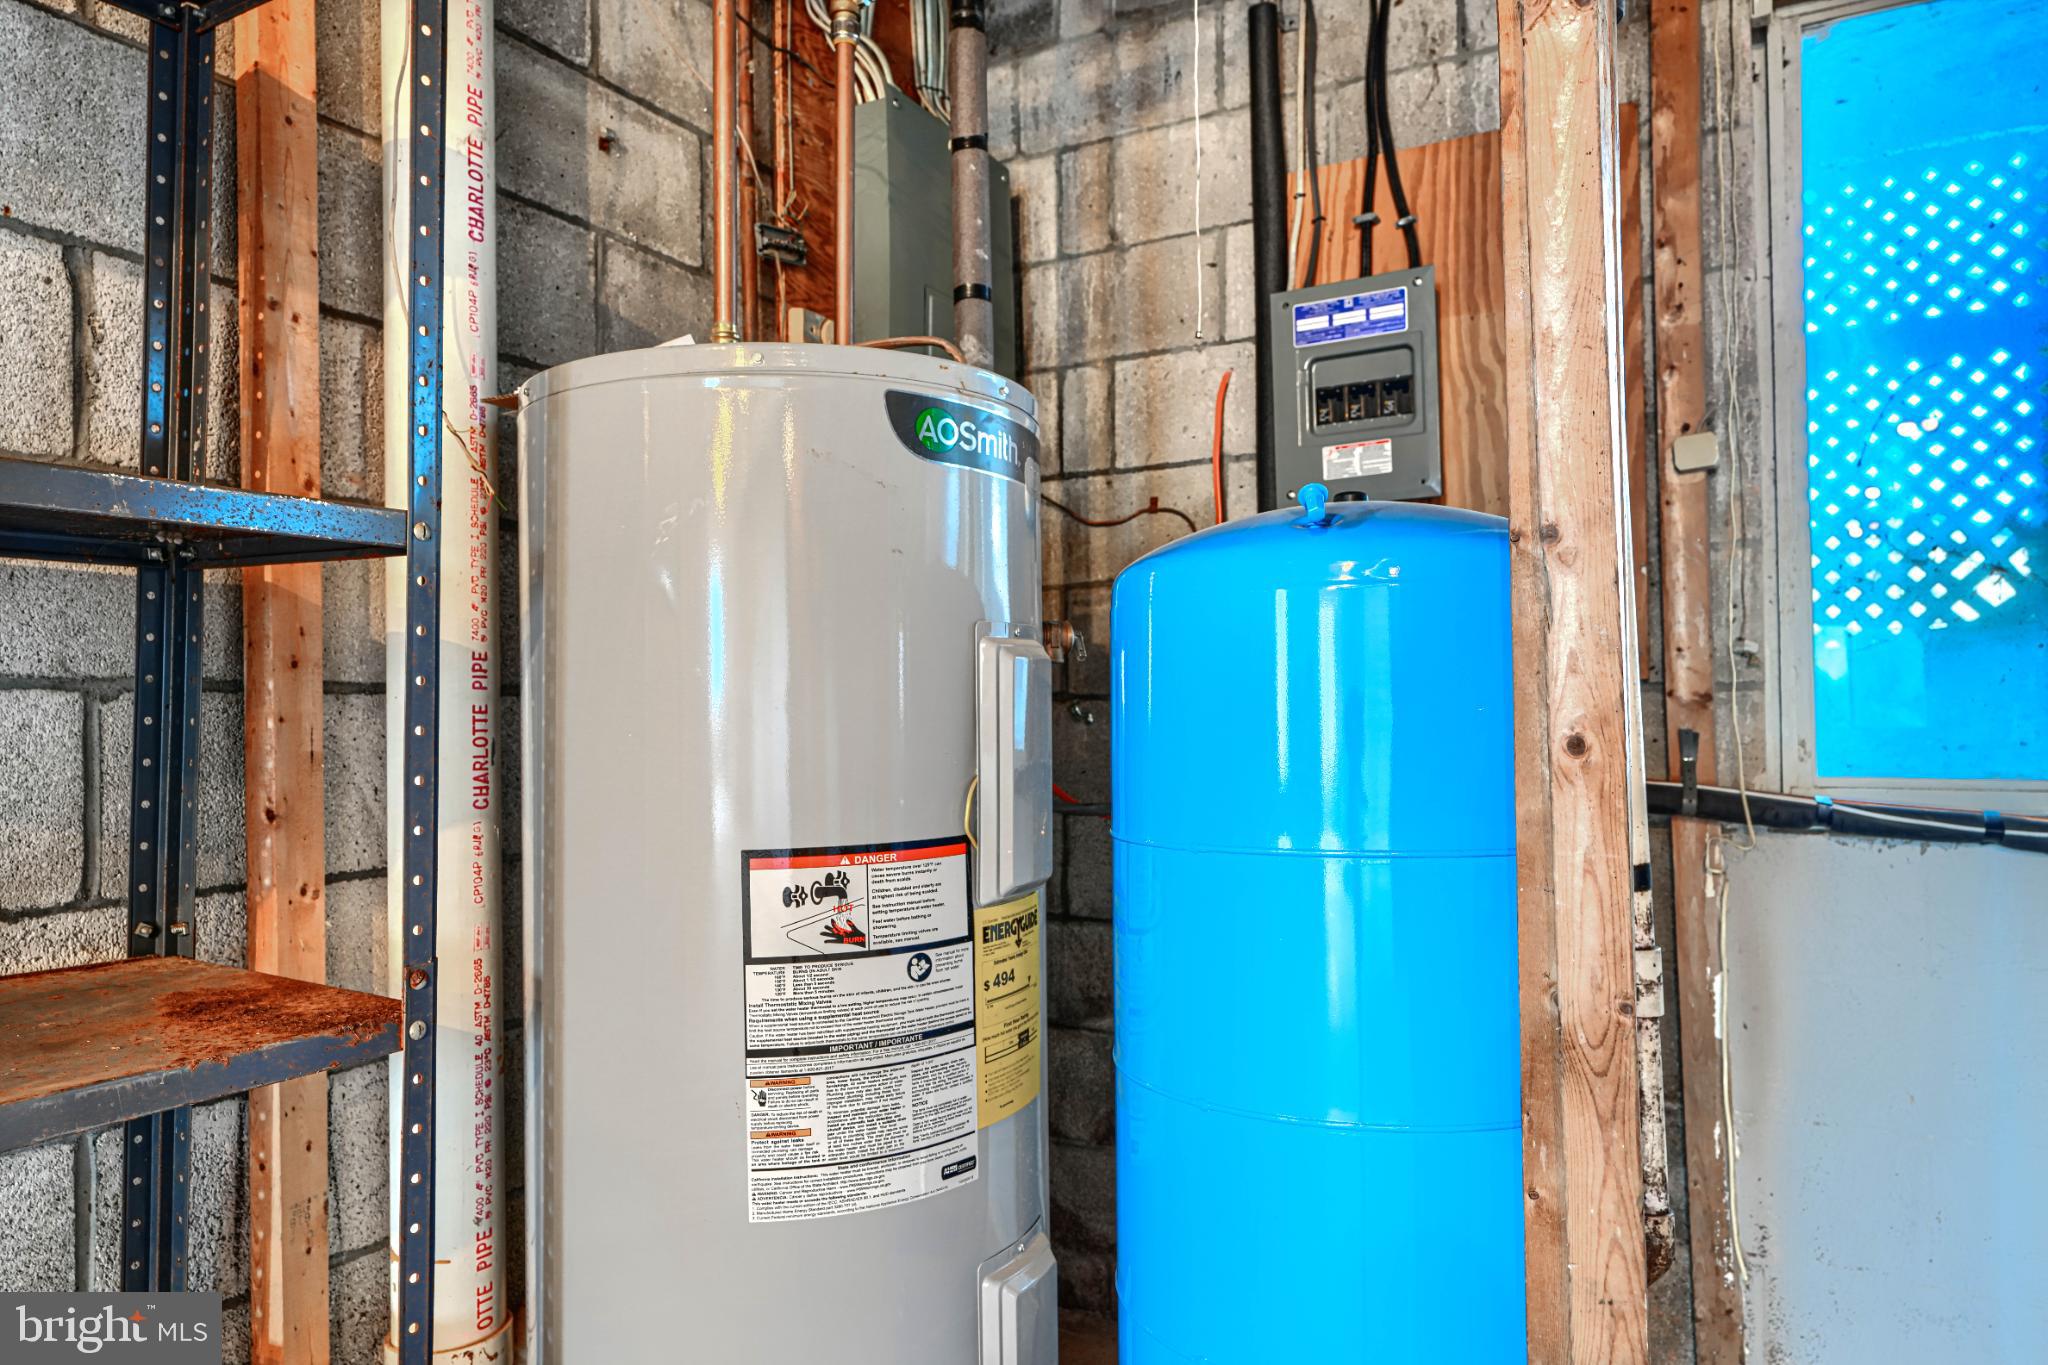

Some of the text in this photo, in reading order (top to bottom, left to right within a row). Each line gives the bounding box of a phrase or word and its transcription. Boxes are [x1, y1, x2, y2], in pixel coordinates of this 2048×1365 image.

[467, 84, 483, 128] PIPE
[467, 134, 485, 243] CHARLOTTE
[470, 477, 480, 529] SCHEDULE
[470, 545, 480, 569] TYPE
[472, 651, 489, 691] PIPE
[472, 704, 490, 811] CHARLOTTE
[854, 853, 897, 864] DANGER
[833, 904, 854, 913] HOT
[843, 936, 865, 944] BURN
[473, 958, 483, 996] D-2665
[984, 968, 1015, 992] $ 494
[474, 1002, 483, 1028] ASTM
[818, 1012, 850, 1020] supplemental
[475, 1035, 483, 1047] 40
[830, 1042, 873, 1053] IMPORTANT
[878, 1034, 923, 1047] IMPORTANTE
[474, 1053, 484, 1106] SCHEDULE
[912, 1100, 928, 1108] NOTICE
[475, 1123, 484, 1149] TYPE
[859, 1159, 887, 1167] conformance
[476, 1226, 493, 1273] PIPE
[476, 1279, 494, 1331] OTTE
